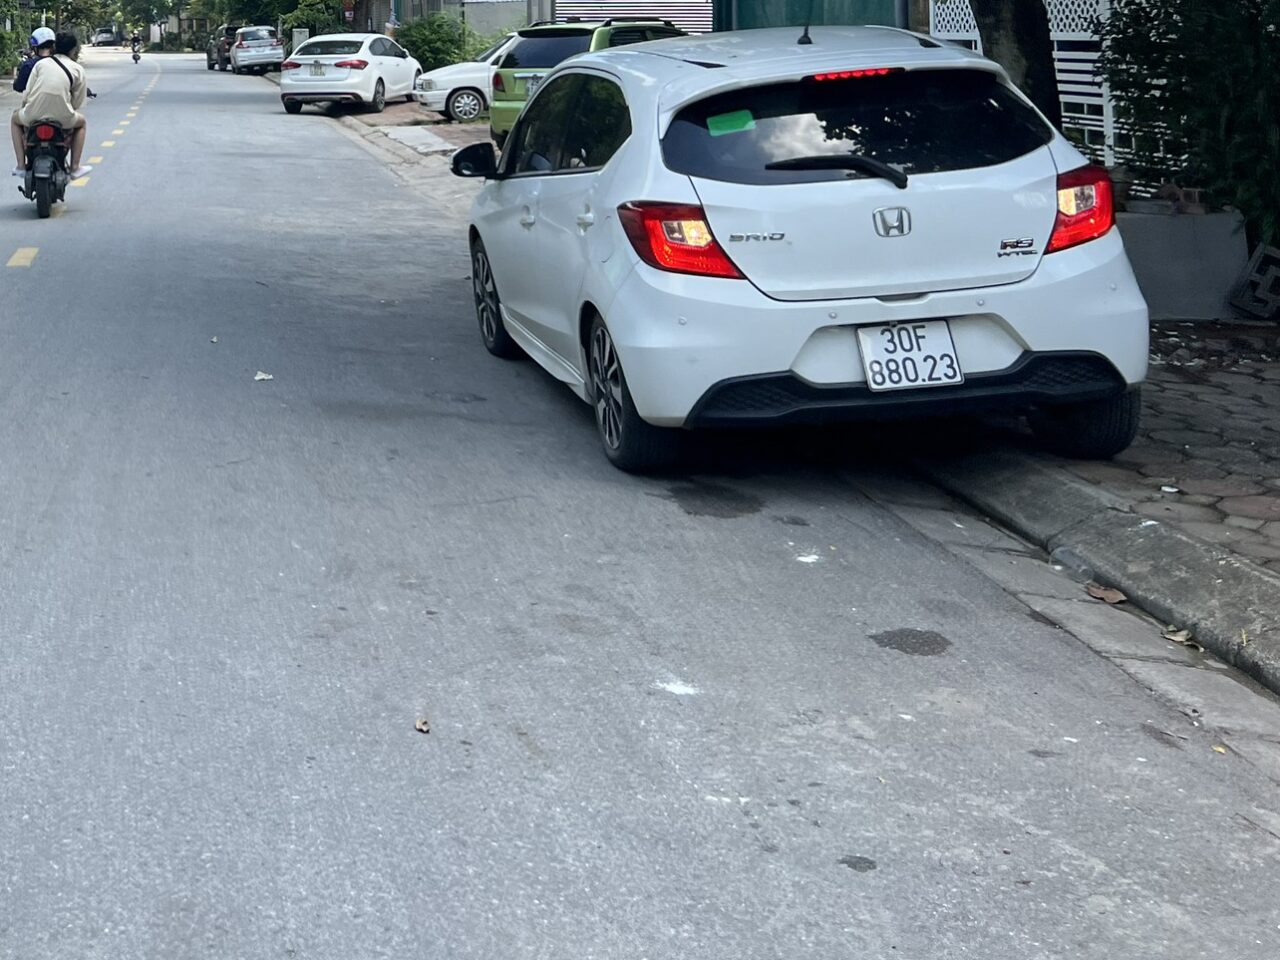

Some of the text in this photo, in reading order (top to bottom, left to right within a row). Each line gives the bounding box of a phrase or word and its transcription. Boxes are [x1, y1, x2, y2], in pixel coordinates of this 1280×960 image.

[1000, 237, 1034, 250] RS
[880, 325, 926, 354] 30F
[869, 353, 958, 386] 880.23
